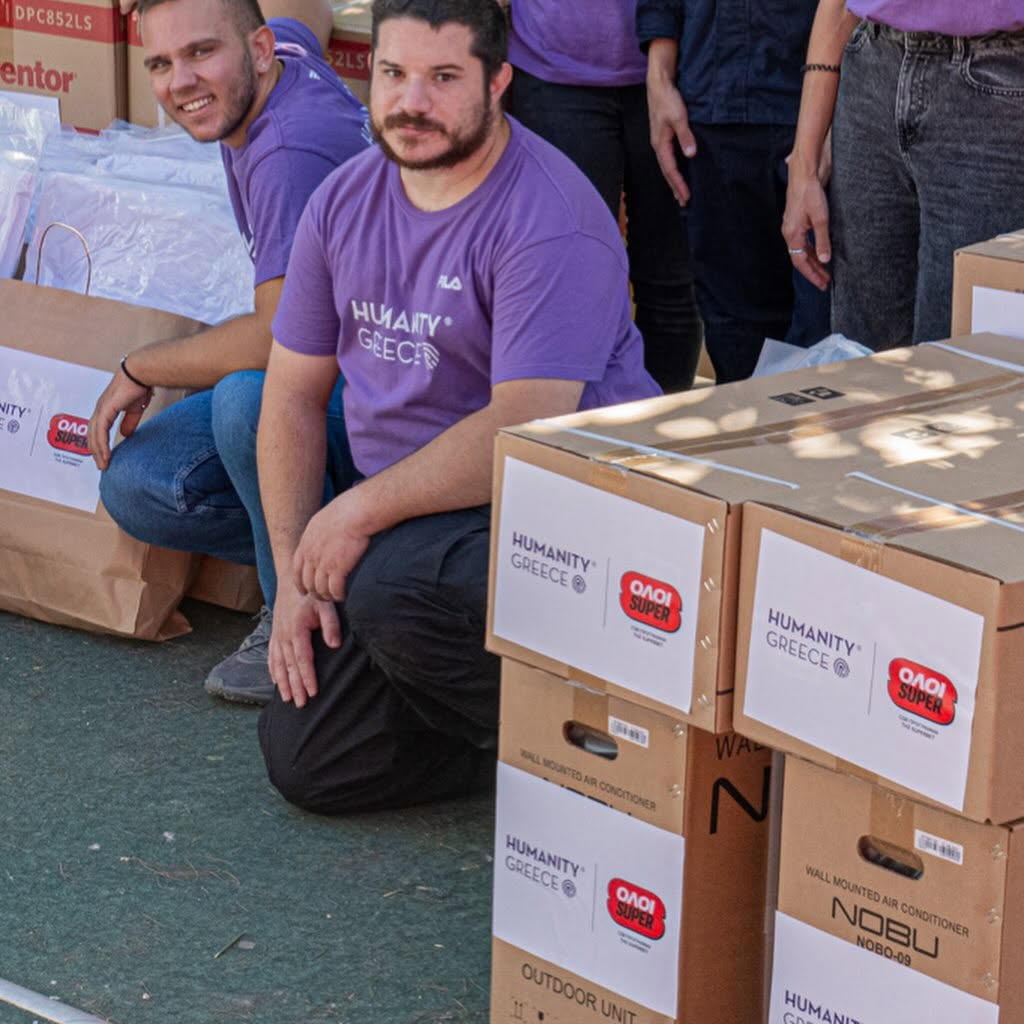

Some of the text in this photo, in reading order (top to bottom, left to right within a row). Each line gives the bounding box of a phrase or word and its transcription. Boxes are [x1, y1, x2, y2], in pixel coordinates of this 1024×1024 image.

[15, 6, 93, 31] DPC852LS
[57, 419, 88, 435] ΟΛΟ
[511, 552, 569, 587] GREECE
[512, 531, 591, 573] HUMANITY
[629, 594, 671, 624] SUPER
[766, 630, 829, 670] GREECE
[768, 608, 856, 657] HUMANITY
[898, 682, 943, 714] SUPER
[716, 735, 766, 760] WA
[520, 748, 541, 766] WALL
[543, 757, 582, 782] MOUNTED
[583, 773, 598, 788] AIR
[599, 778, 657, 812] CONDITIONER
[505, 855, 559, 892] GREECE
[506, 834, 580, 878] HUMANITY
[615, 900, 655, 930] SUPER
[805, 864, 970, 938] WALL MOUNTED AIR CONDITIONER
[832, 896, 939, 959] NOBU
[856, 934, 912, 967] NOBO-09
[521, 963, 637, 1024] OUTDOOR UNIT
[784, 989, 862, 1024] HUMANI
